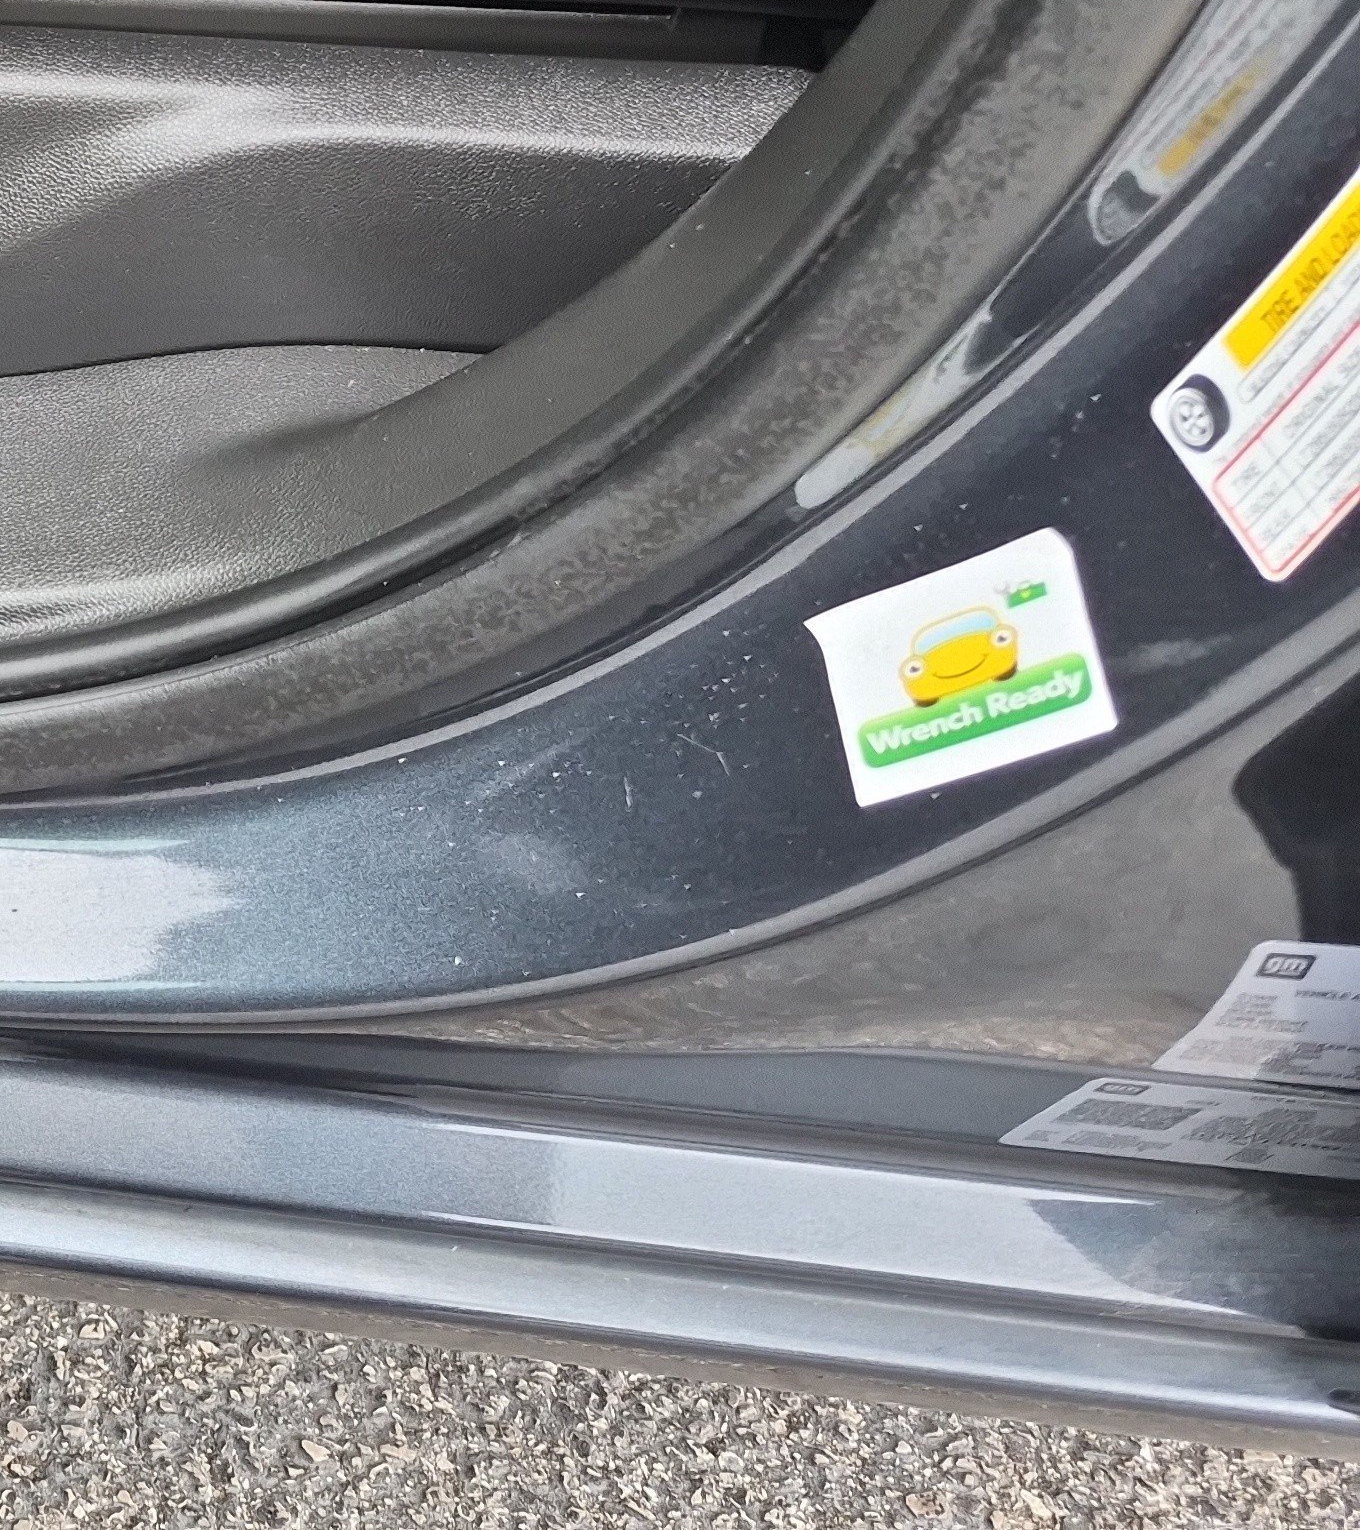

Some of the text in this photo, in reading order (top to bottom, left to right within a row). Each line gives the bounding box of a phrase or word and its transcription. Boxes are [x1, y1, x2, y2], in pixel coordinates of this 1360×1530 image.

[1260, 289, 1302, 333] TIRE
[1293, 256, 1326, 298] AND
[866, 670, 1084, 755] Wrench Ready
